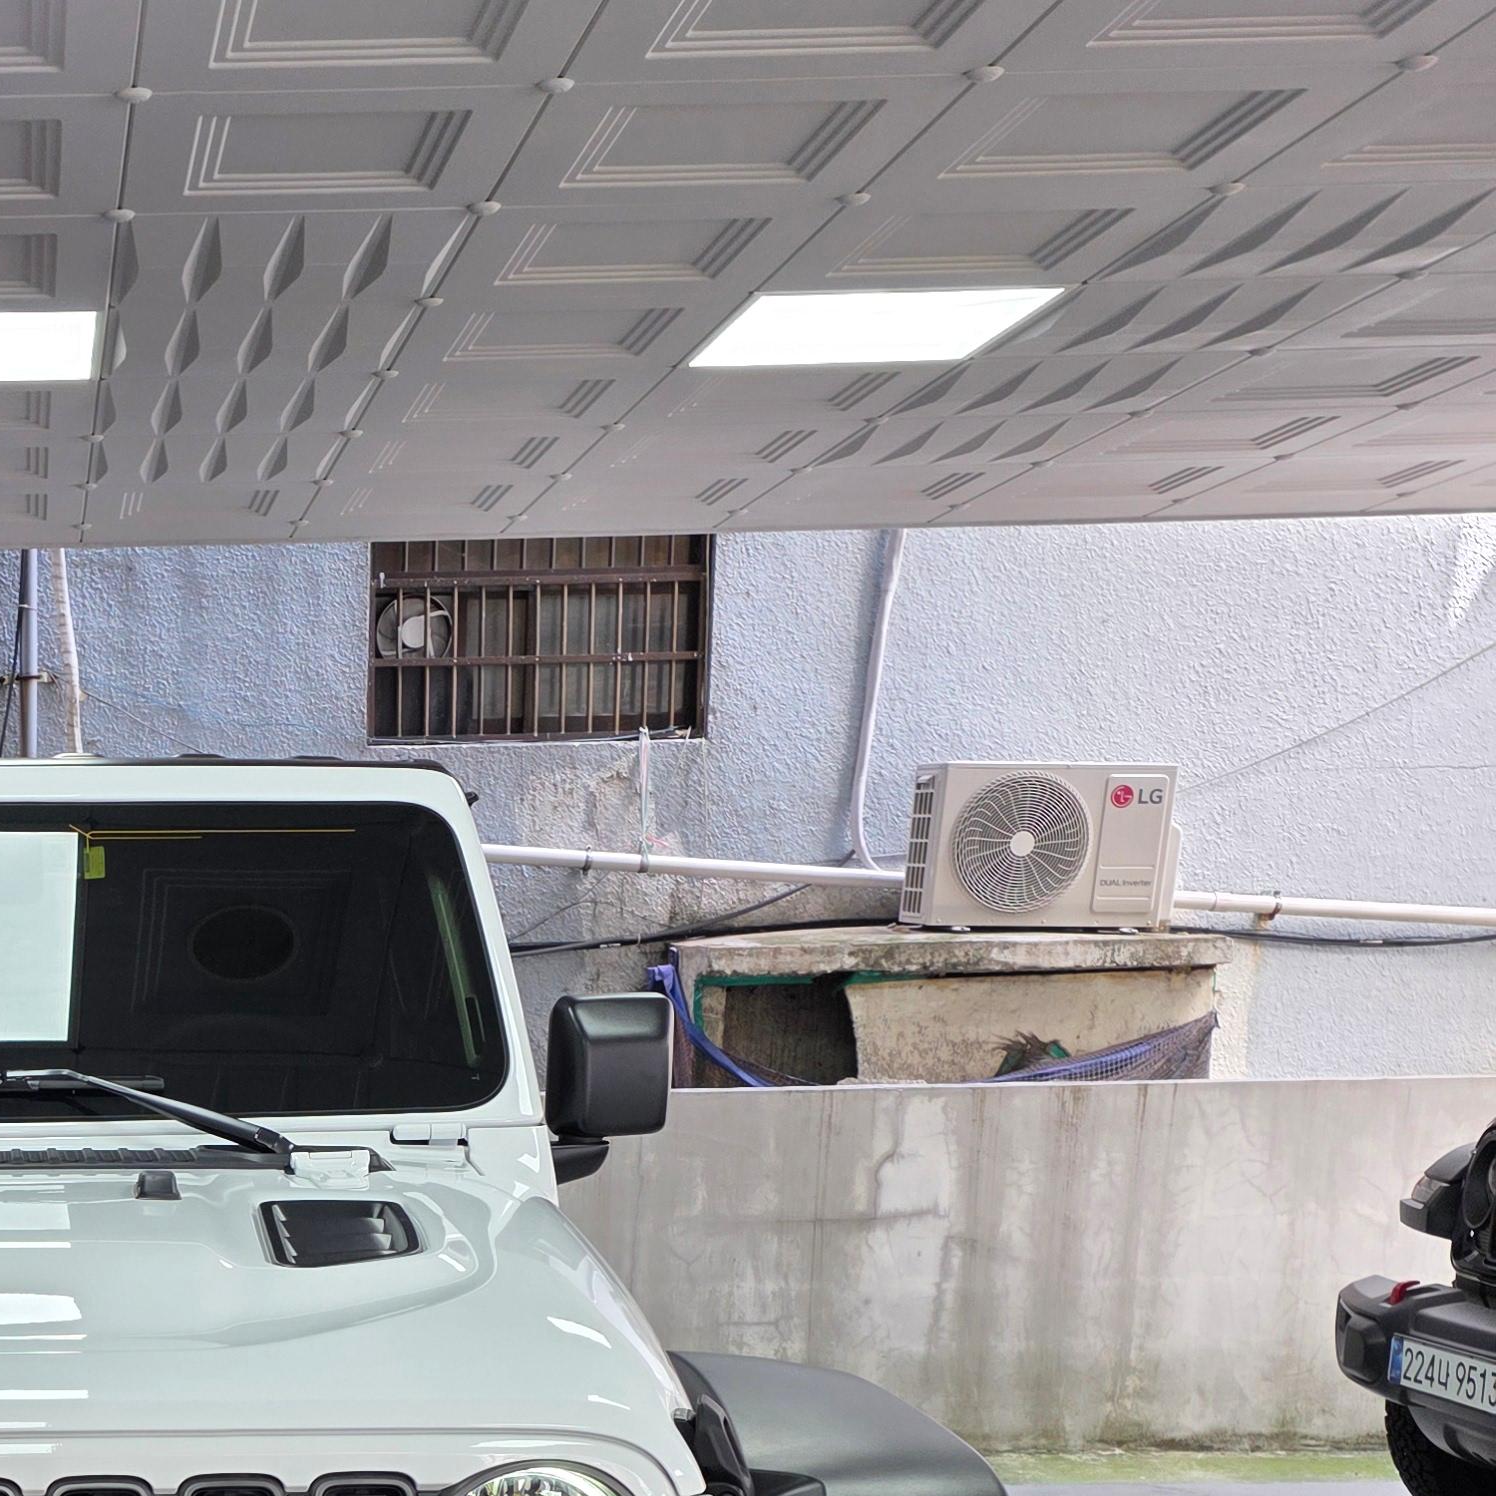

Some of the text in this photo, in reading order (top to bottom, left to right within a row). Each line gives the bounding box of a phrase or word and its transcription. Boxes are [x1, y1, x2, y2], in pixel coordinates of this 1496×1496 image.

[1137, 788, 1164, 805] LG
[1099, 879, 1152, 888] DUAL Inverter
[1402, 1347, 1496, 1407] 224너 9513
